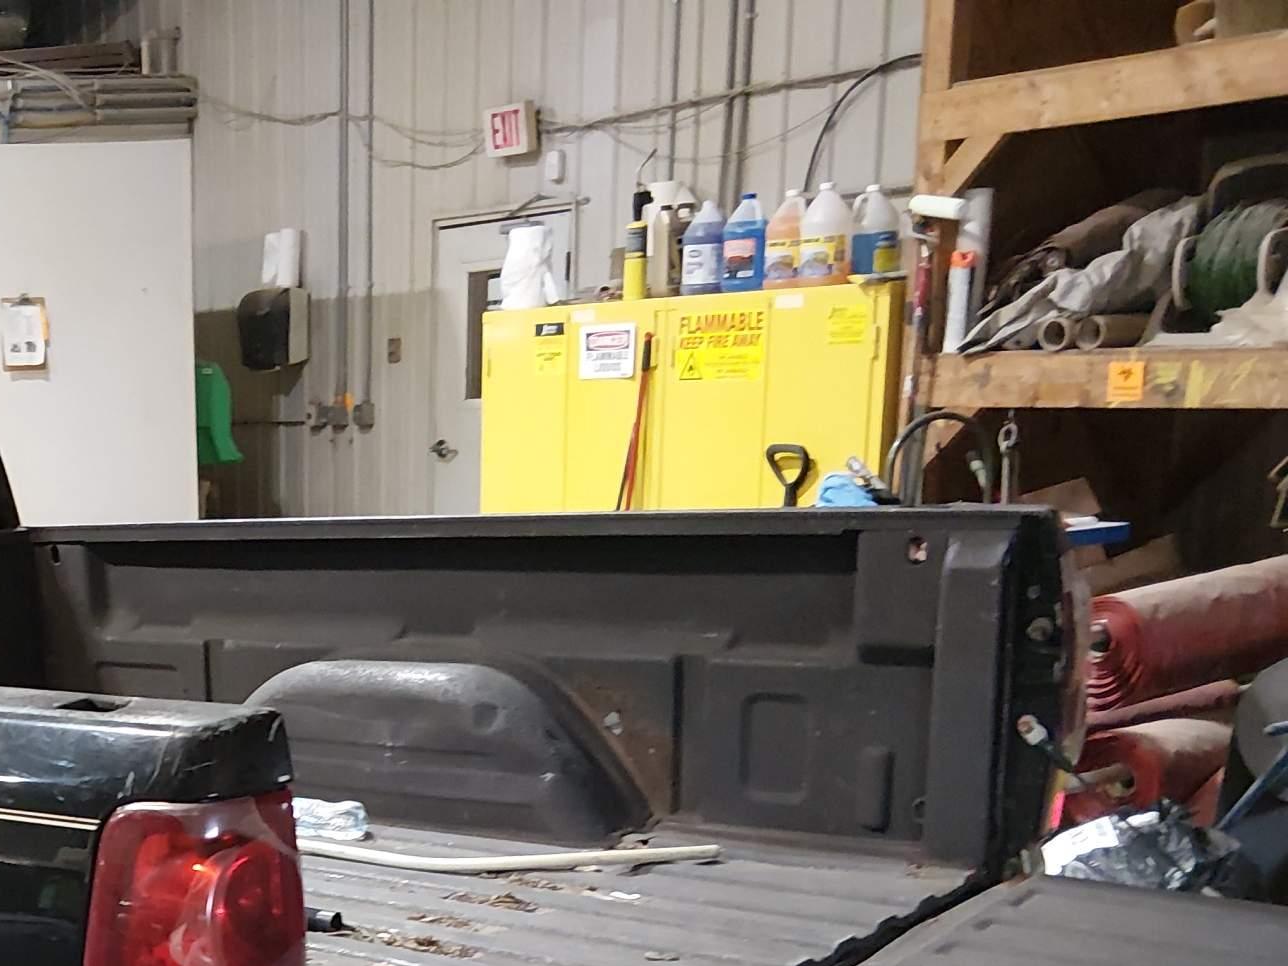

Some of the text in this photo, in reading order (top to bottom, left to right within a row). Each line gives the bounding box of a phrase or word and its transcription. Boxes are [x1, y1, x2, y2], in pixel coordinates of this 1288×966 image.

[491, 109, 520, 150] EXIT
[679, 311, 763, 334] FLAMMABLE
[679, 333, 761, 349] KEEP FIRE AWAY
